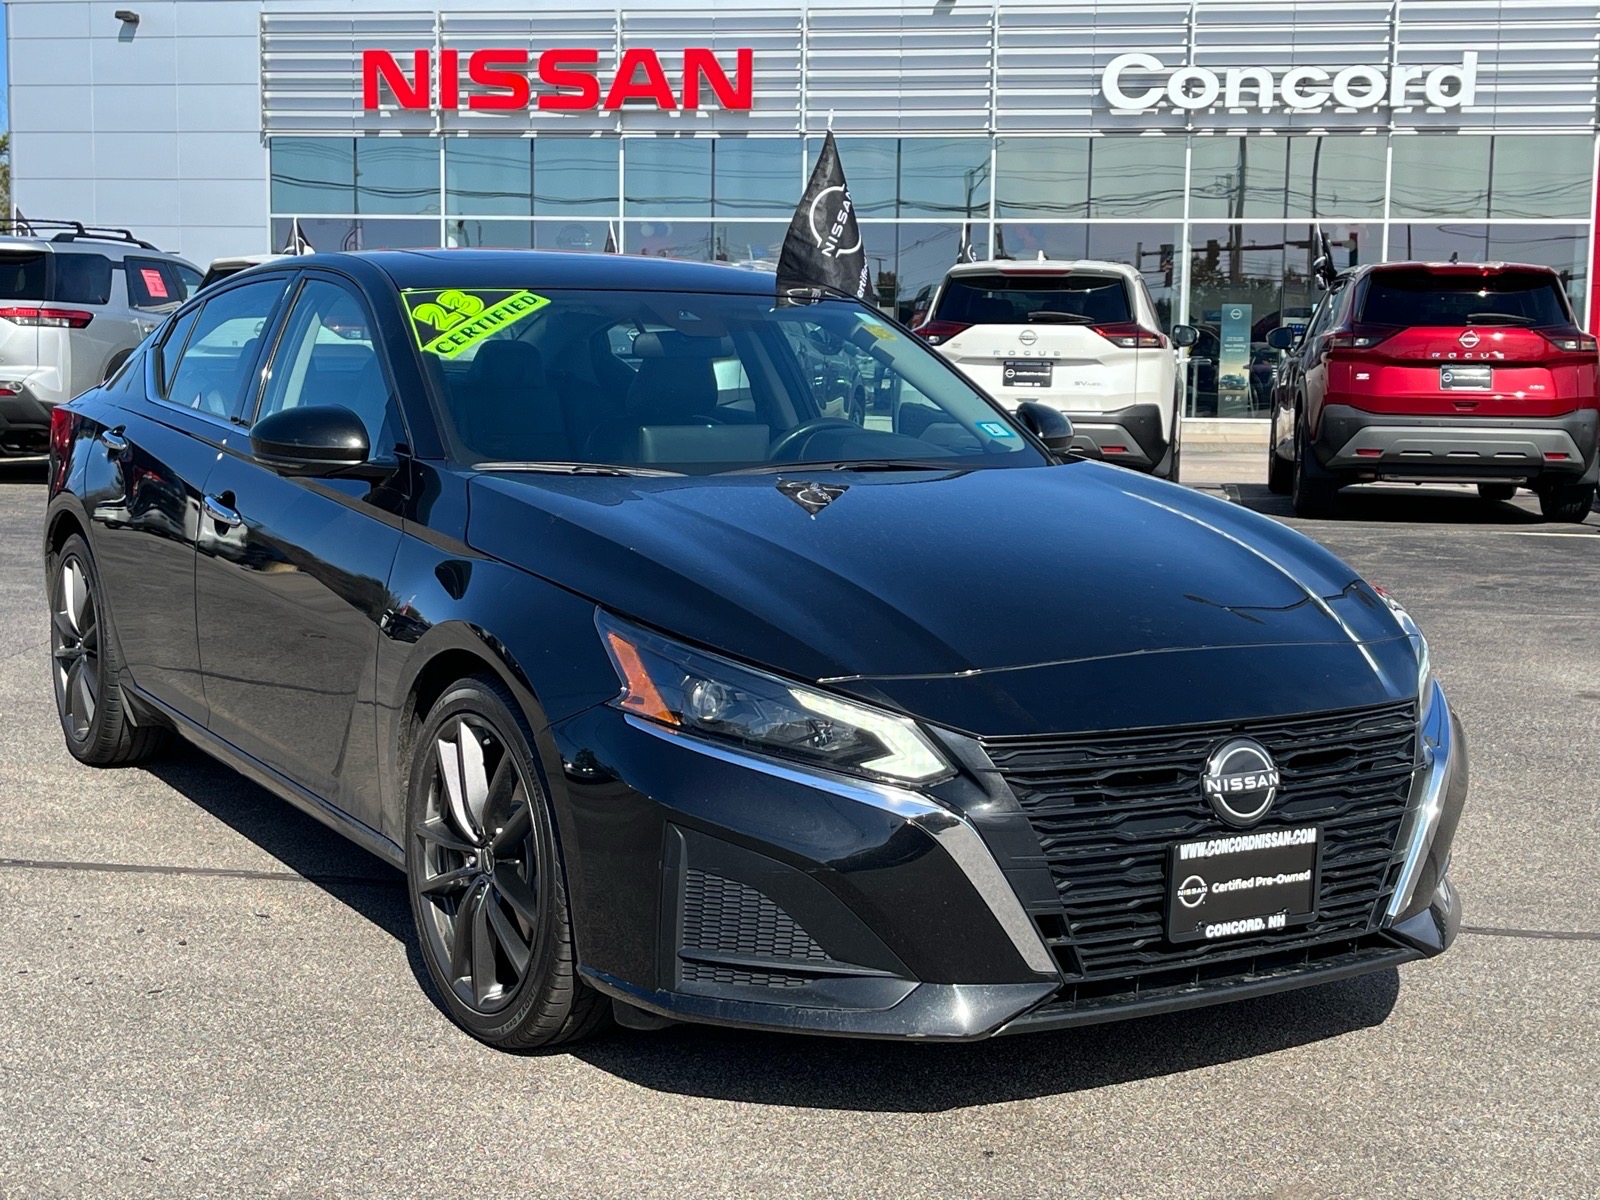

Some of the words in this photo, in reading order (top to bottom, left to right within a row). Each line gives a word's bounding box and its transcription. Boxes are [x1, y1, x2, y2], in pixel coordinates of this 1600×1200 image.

[363, 48, 753, 110] NISSAN
[1102, 51, 1478, 109] Concord
[412, 290, 484, 331] 23
[434, 295, 538, 354] CERTIFIED
[1206, 771, 1280, 793] NISSAN
[1180, 828, 1317, 860] WWW.CONCORDNISSAN.COM
[1177, 886, 1208, 896] NISSAN
[1211, 877, 1255, 893] Certified
[1255, 869, 1312, 888] Pre-Owned
[1205, 917, 1266, 938] CONCORD,
[1268, 913, 1286, 929] NH
